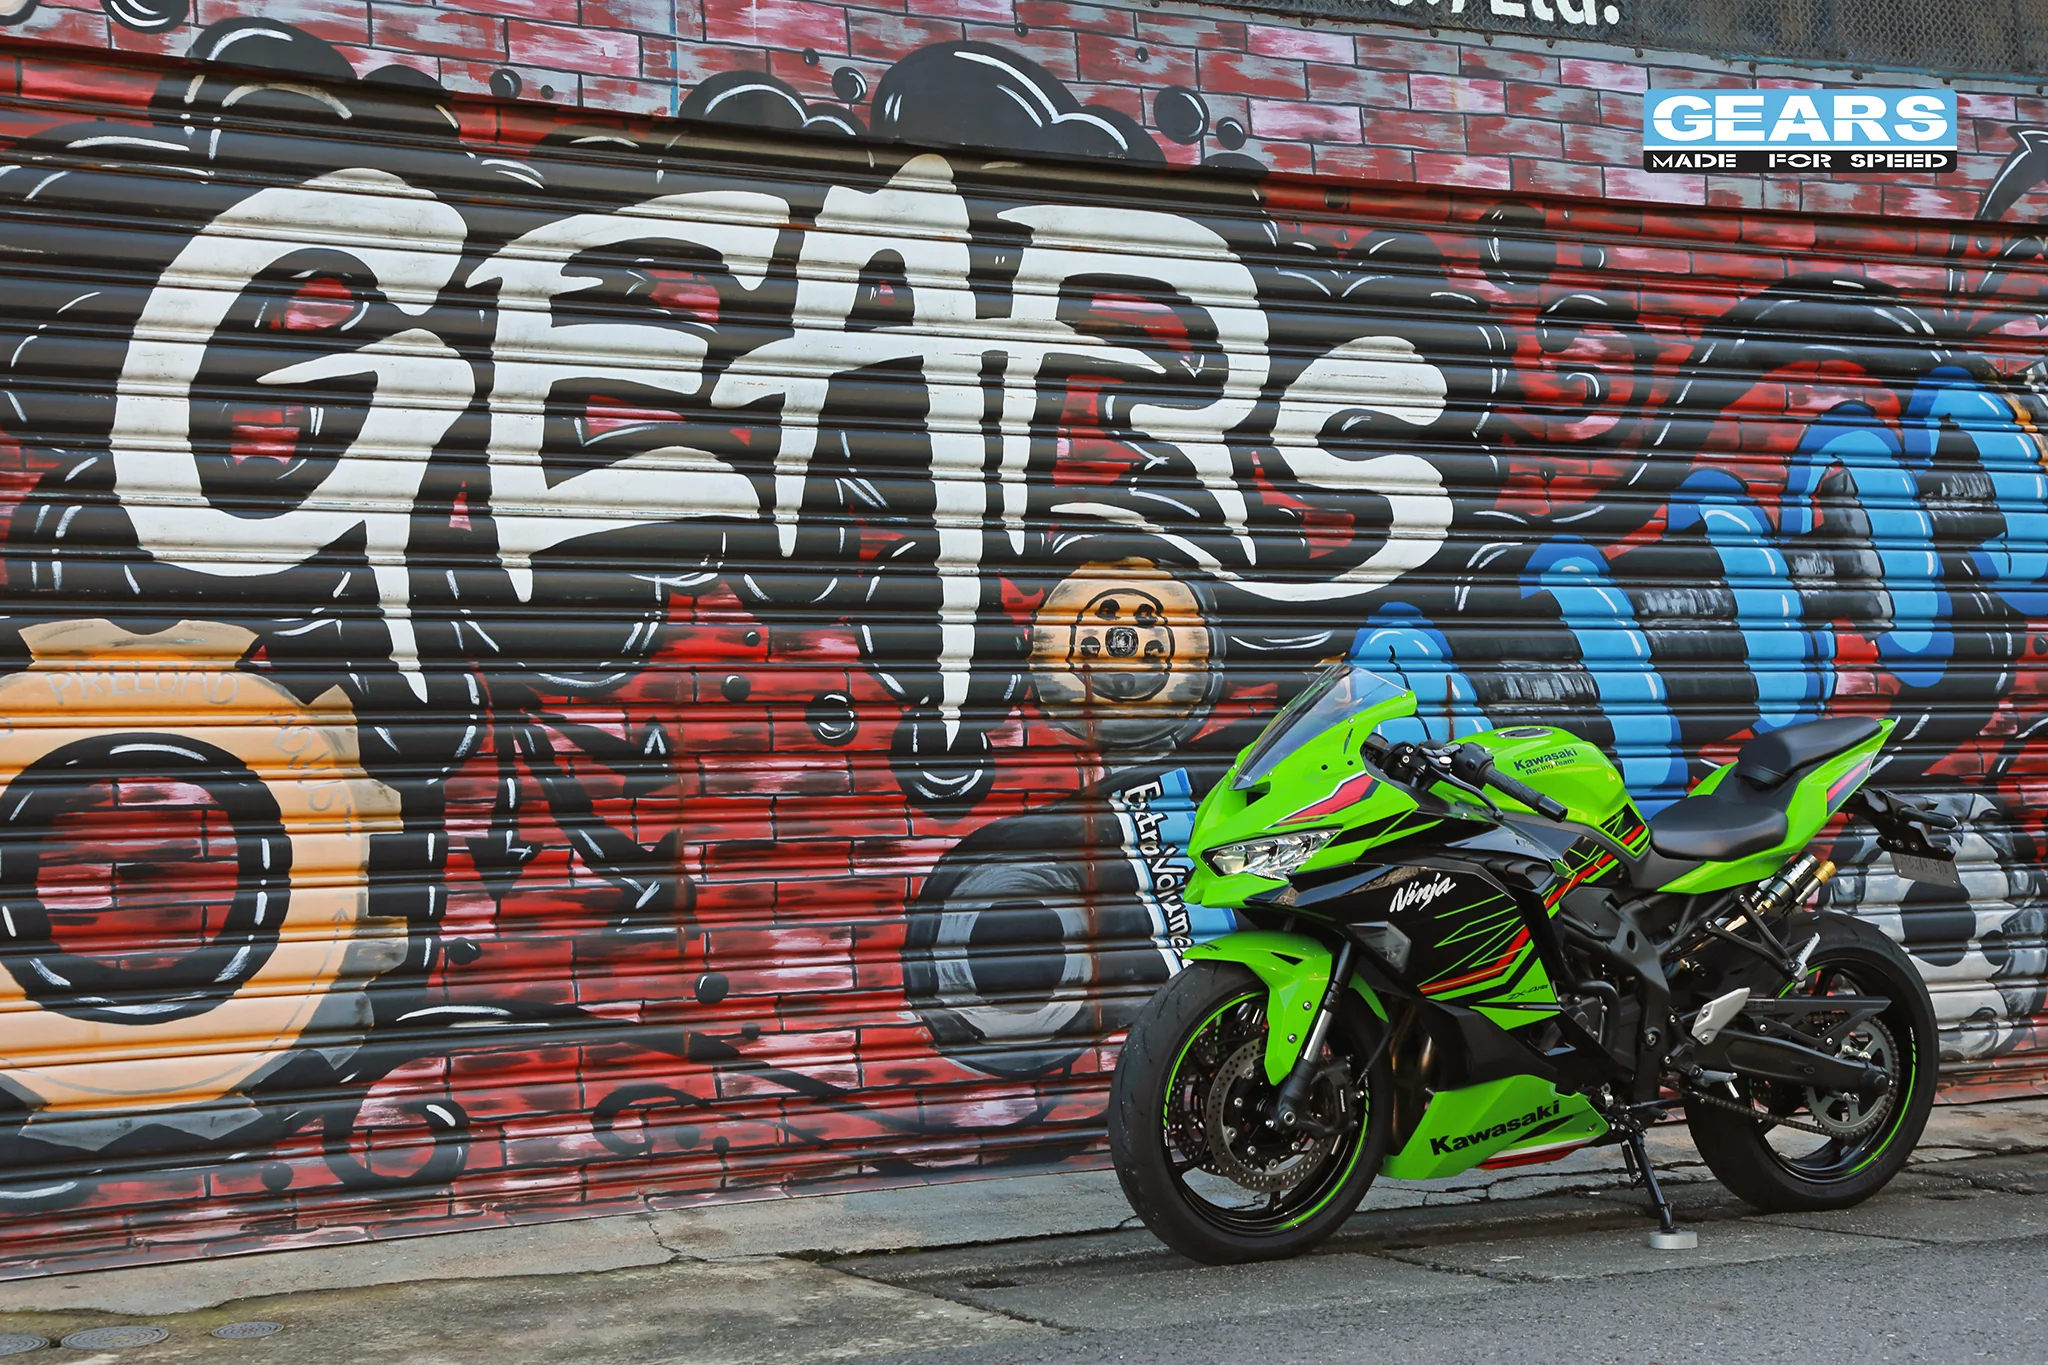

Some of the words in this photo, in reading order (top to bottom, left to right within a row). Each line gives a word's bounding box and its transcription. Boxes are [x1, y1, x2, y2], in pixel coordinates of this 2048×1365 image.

[110, 154, 1454, 750] GEARS
[44, 660, 239, 705] PRELOAD
[1513, 747, 1579, 771] Kawasaki
[1525, 763, 1554, 775] Racing
[1389, 872, 1457, 913] Ninja
[1430, 1100, 1560, 1156] Kawasaki
